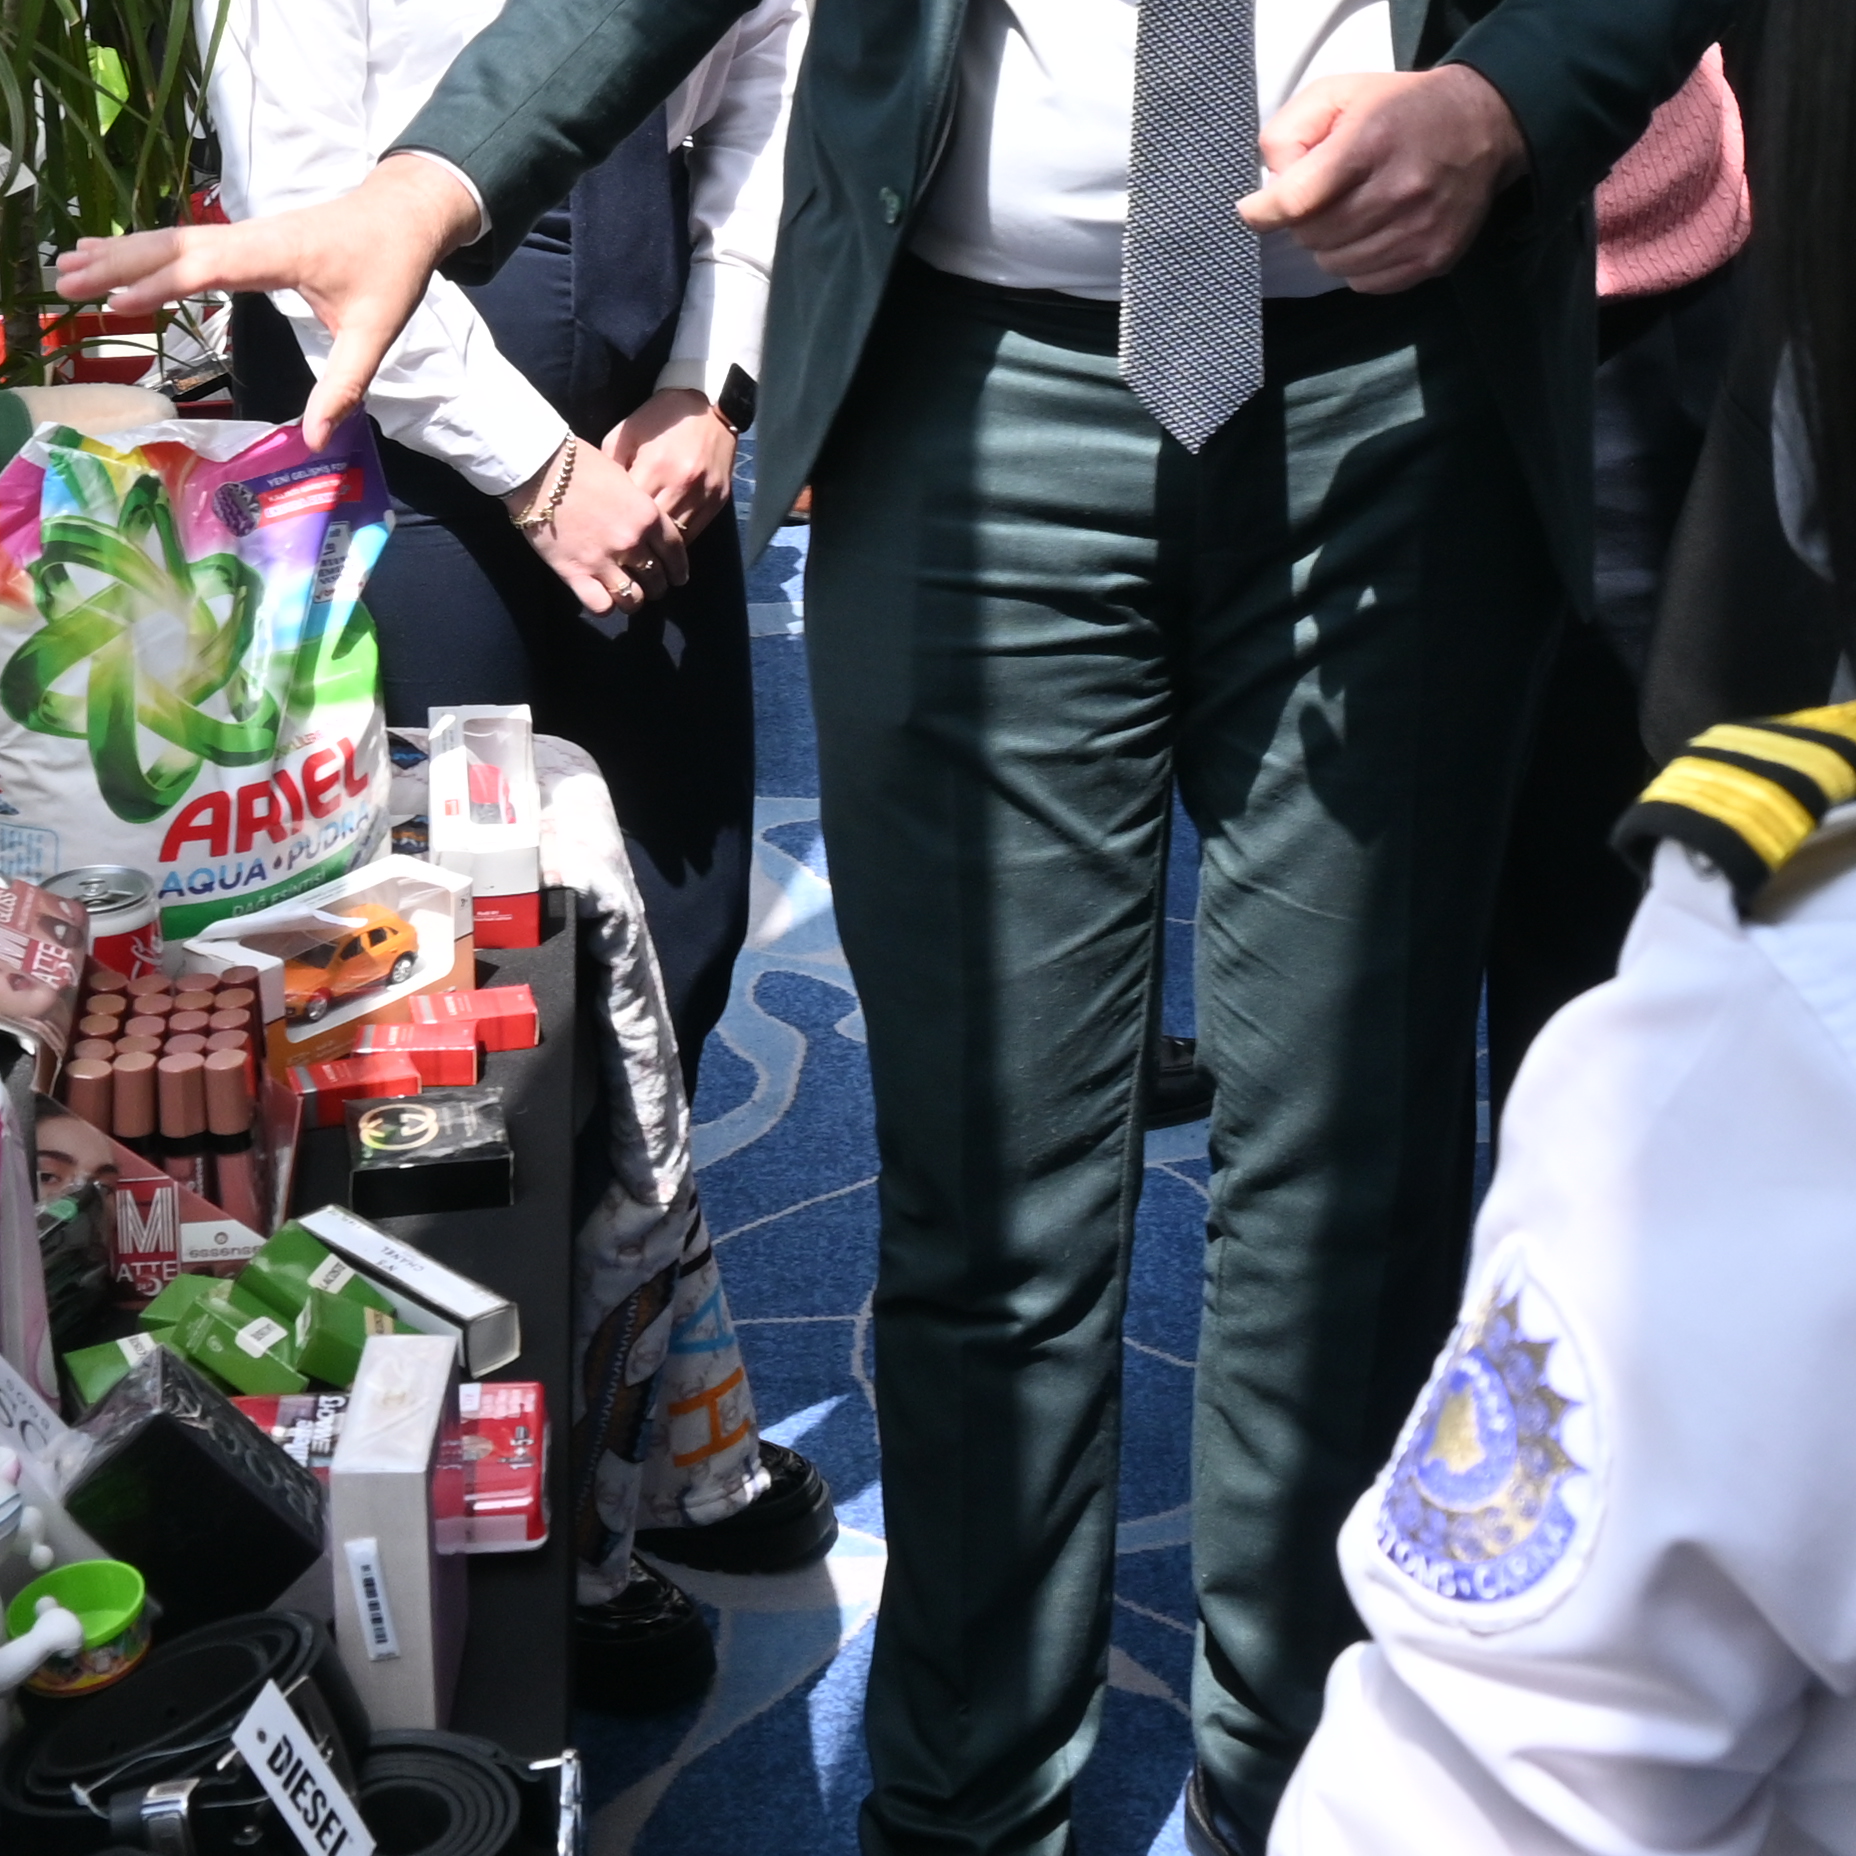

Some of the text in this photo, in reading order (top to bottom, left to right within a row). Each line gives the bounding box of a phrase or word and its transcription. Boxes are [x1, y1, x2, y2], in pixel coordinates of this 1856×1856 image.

[158, 800, 370, 899] AQUA PUDRA
[159, 737, 369, 863] ARIEL
